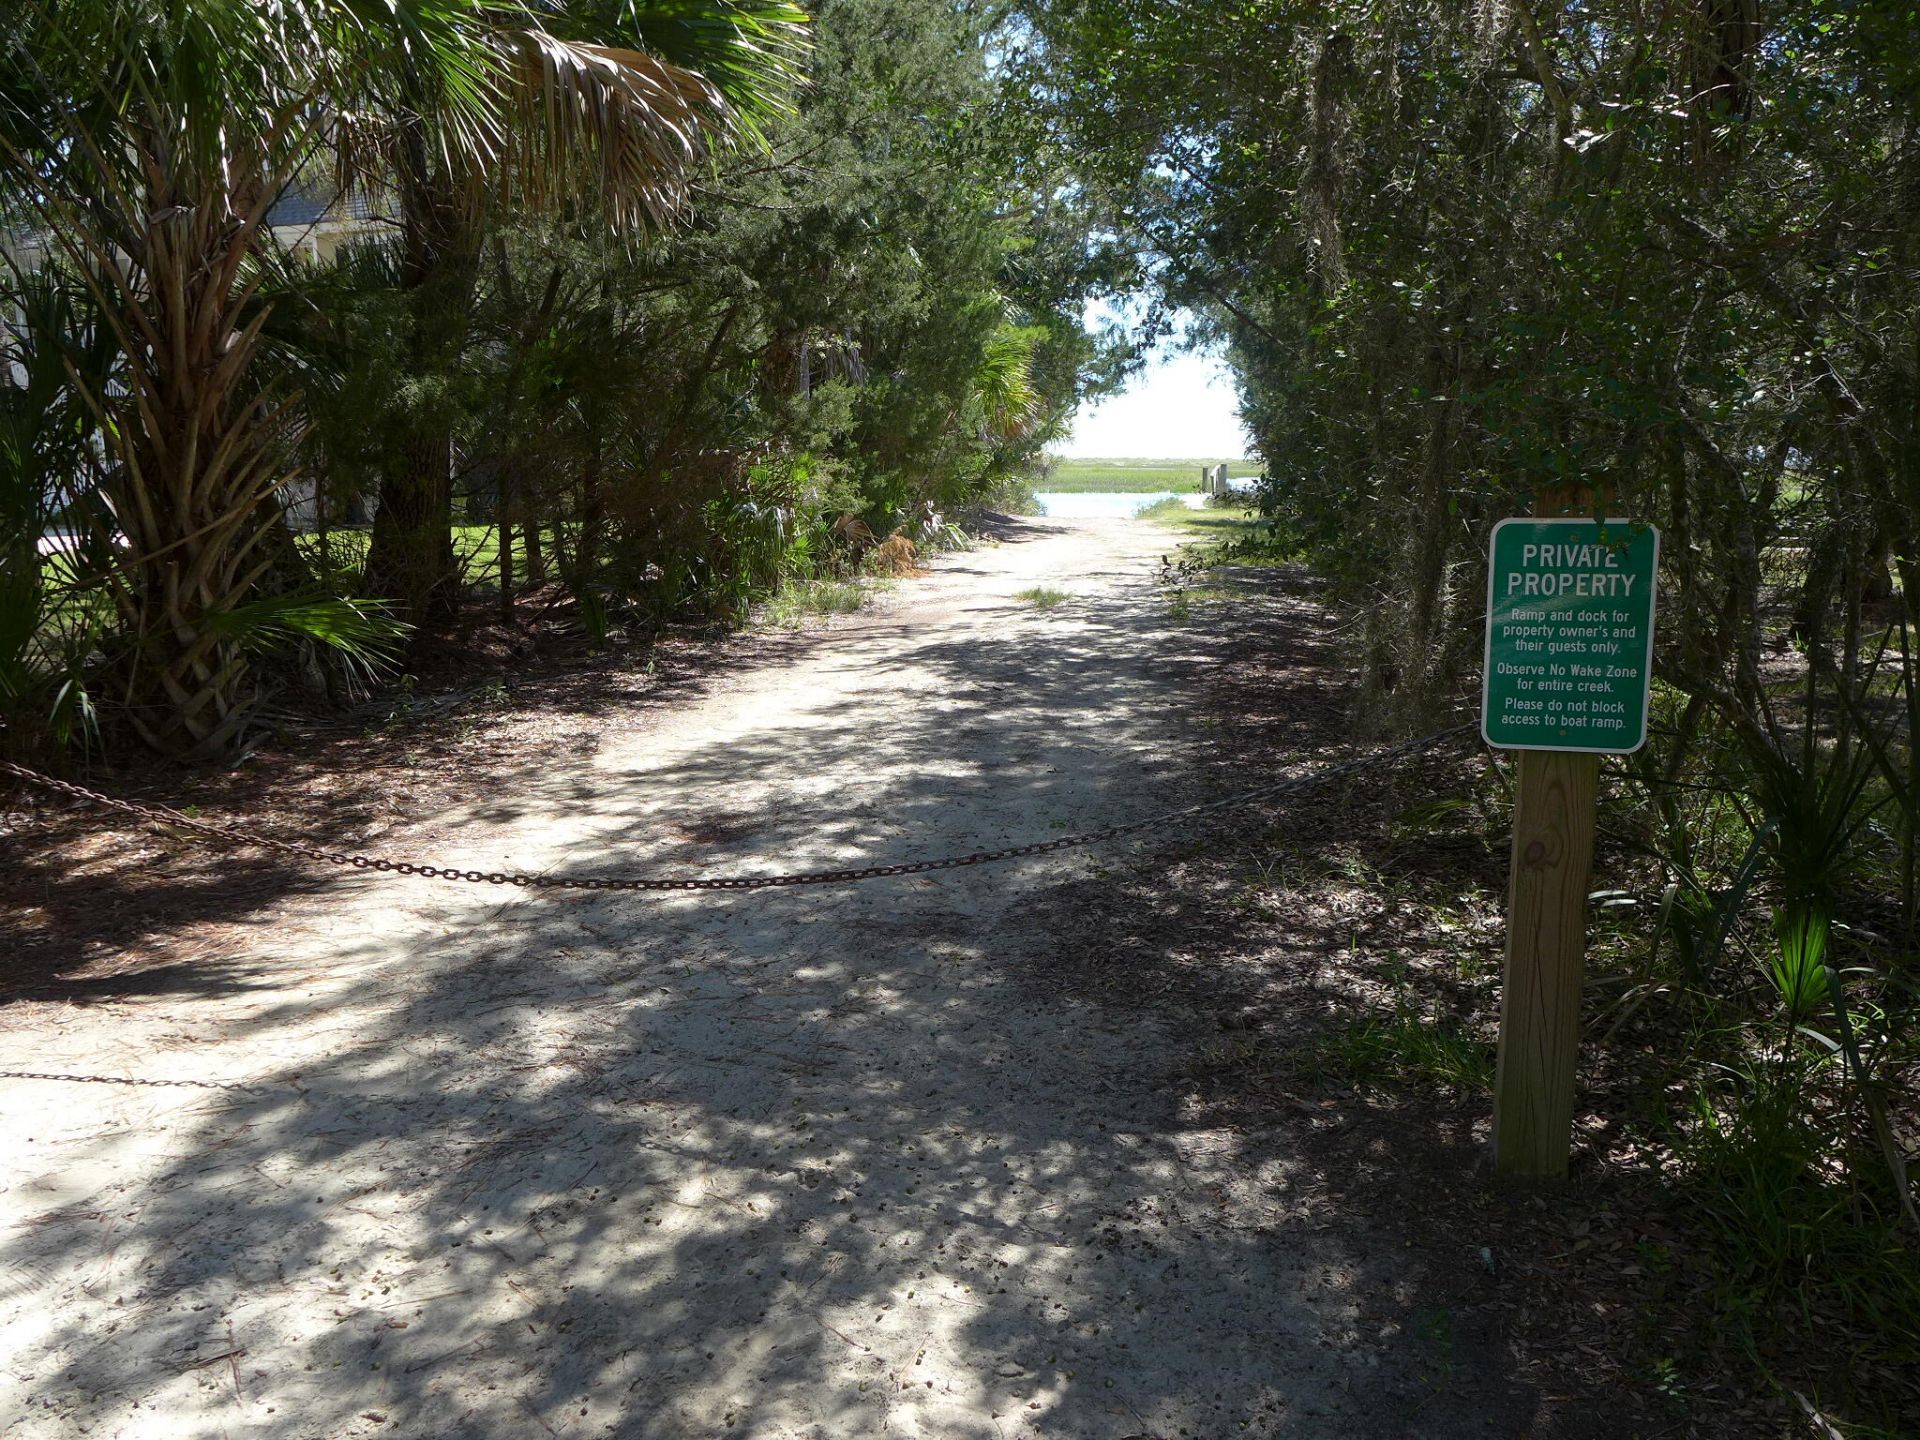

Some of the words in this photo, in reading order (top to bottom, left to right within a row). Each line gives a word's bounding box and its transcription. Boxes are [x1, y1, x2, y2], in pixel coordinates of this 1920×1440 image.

[1523, 544, 1618, 568] PRIVATE
[1508, 573, 1637, 596] PROPERTY
[1511, 609, 1545, 622] Ramp
[1550, 609, 1572, 621] and
[1578, 609, 1607, 622] dock
[1612, 610, 1629, 622] for
[1503, 624, 1554, 638] property
[1559, 626, 1608, 637] owner's
[1613, 626, 1636, 638] and
[1515, 640, 1543, 651] their
[1548, 641, 1586, 654] guests
[1591, 642, 1621, 655] only.
[1497, 663, 1545, 675] Observe
[1550, 664, 1566, 676] No
[1571, 664, 1601, 676] Wake
[1607, 665, 1637, 678] Zone
[1517, 678, 1534, 690] for
[1538, 679, 1573, 691] entire
[1578, 681, 1614, 692] creek.
[1505, 698, 1543, 710] Please
[1548, 699, 1562, 711] do
[1568, 700, 1587, 712] not
[1591, 700, 1624, 713] block
[1501, 715, 1540, 725] access
[1545, 715, 1556, 726] to
[1561, 715, 1587, 727] boat
[1591, 717, 1626, 730] ramp.
